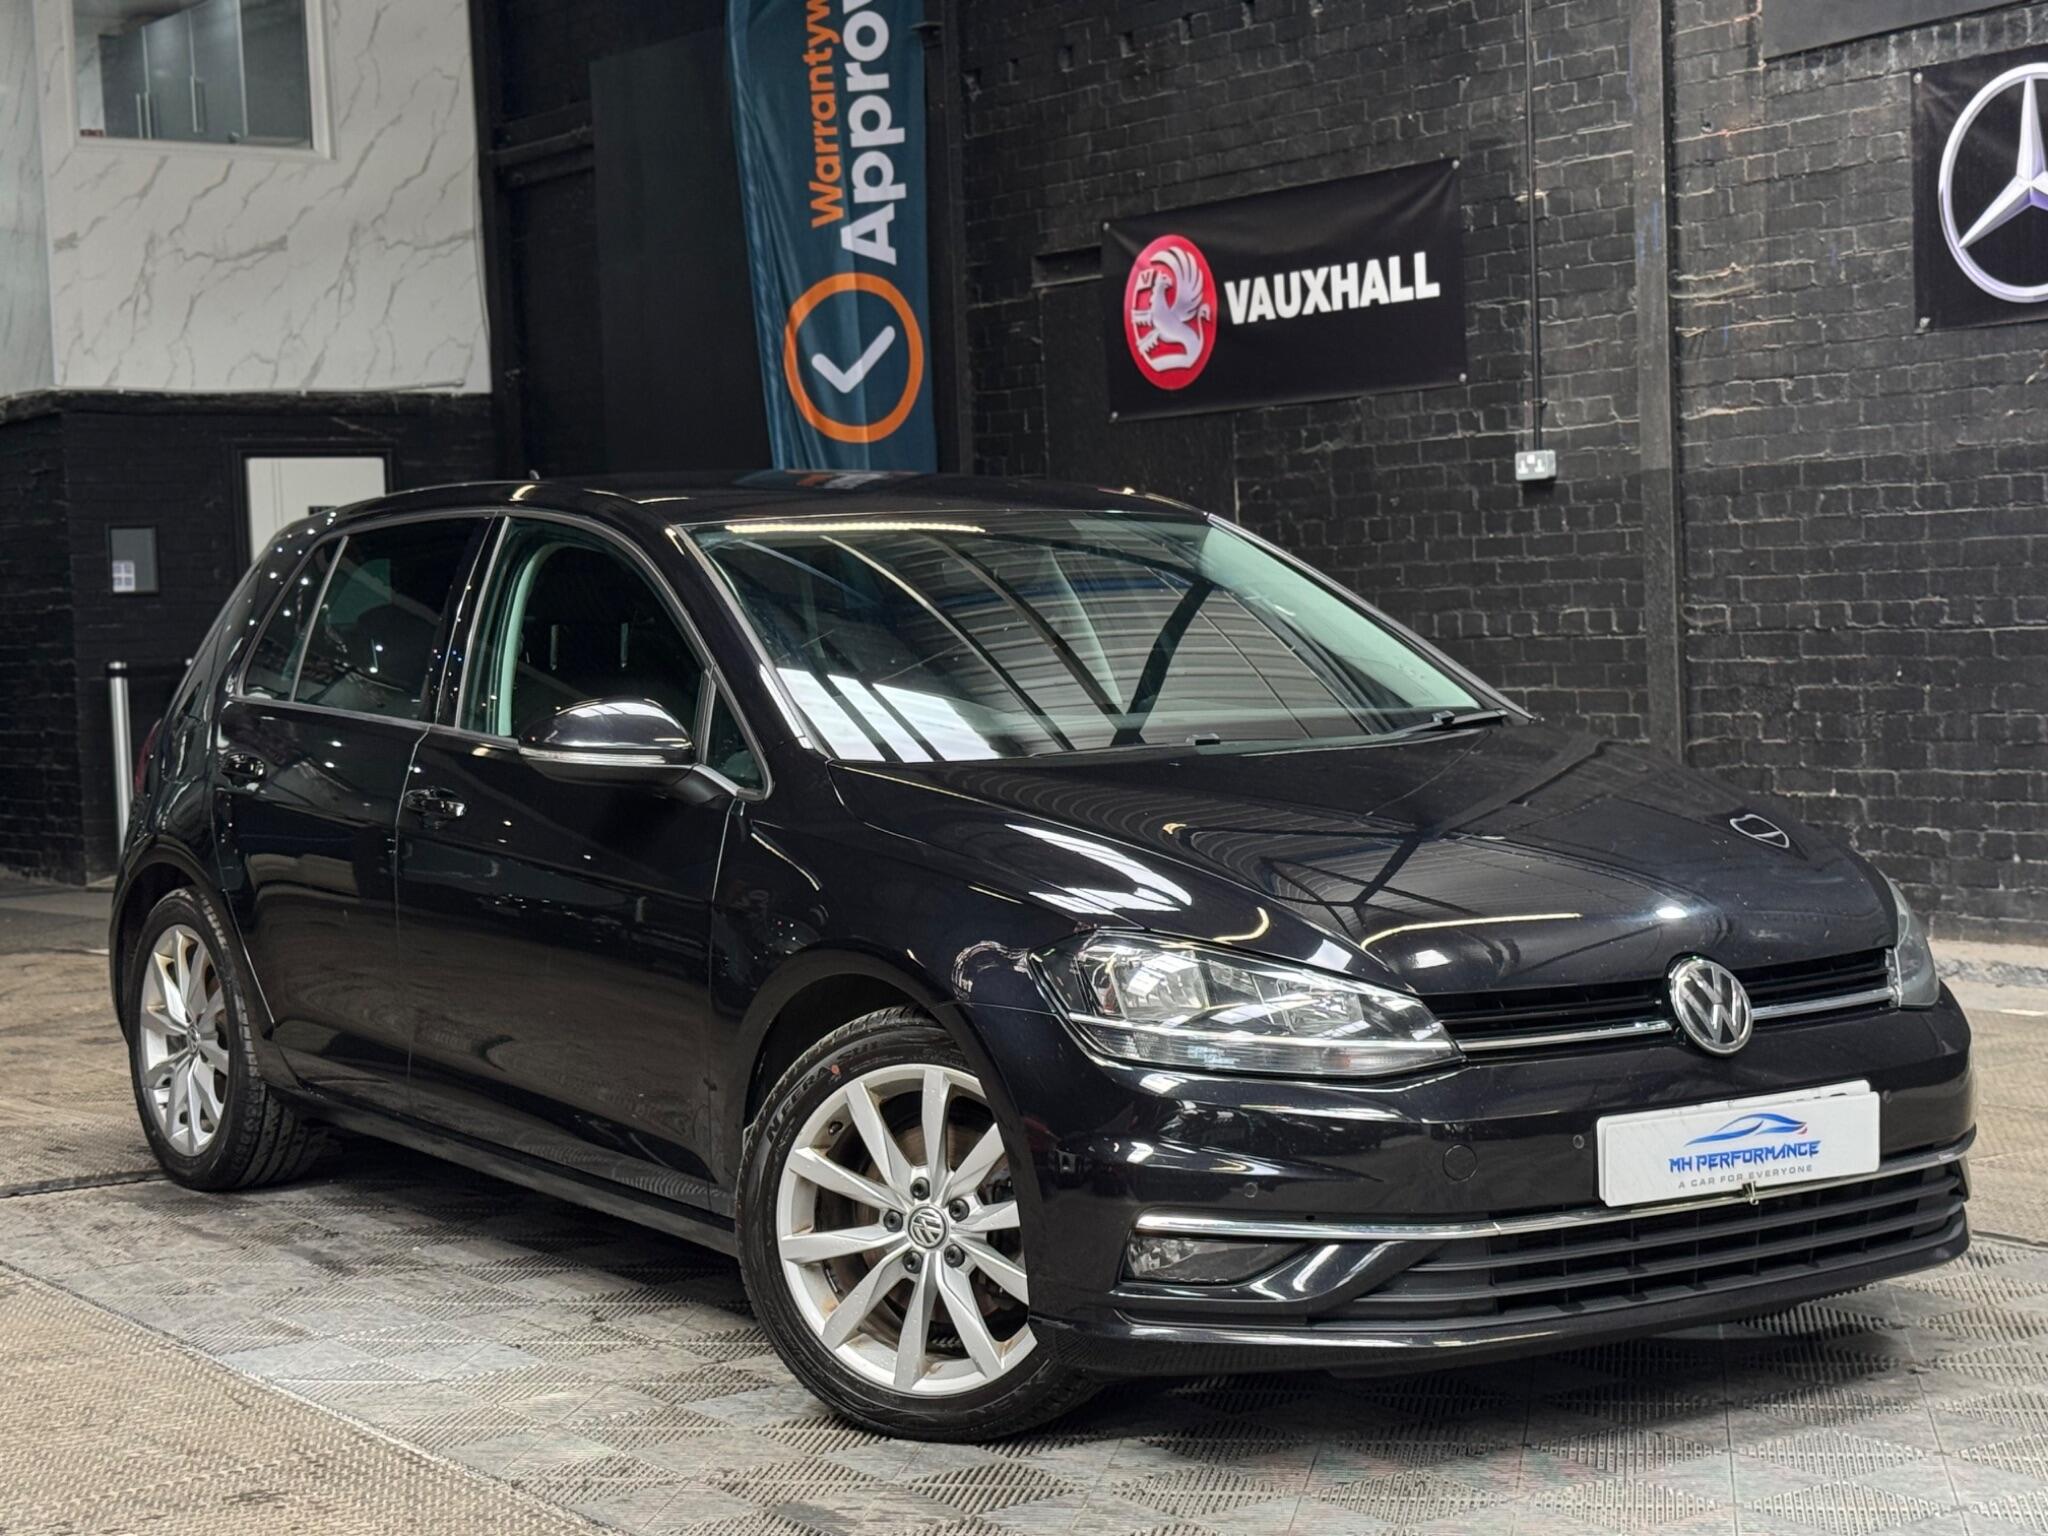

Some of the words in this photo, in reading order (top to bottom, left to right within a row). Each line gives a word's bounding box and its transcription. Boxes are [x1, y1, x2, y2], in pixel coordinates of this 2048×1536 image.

[1224, 251, 1441, 325] VAUXHALL
[1668, 1155, 1693, 1174] MH
[1695, 1140, 1822, 1172] PERFORMANCE
[1678, 1181, 1686, 1190] A
[1690, 1177, 1716, 1188] CAR
[1720, 1173, 1744, 1184] FOR
[1748, 1164, 1813, 1180] EVERYONE
